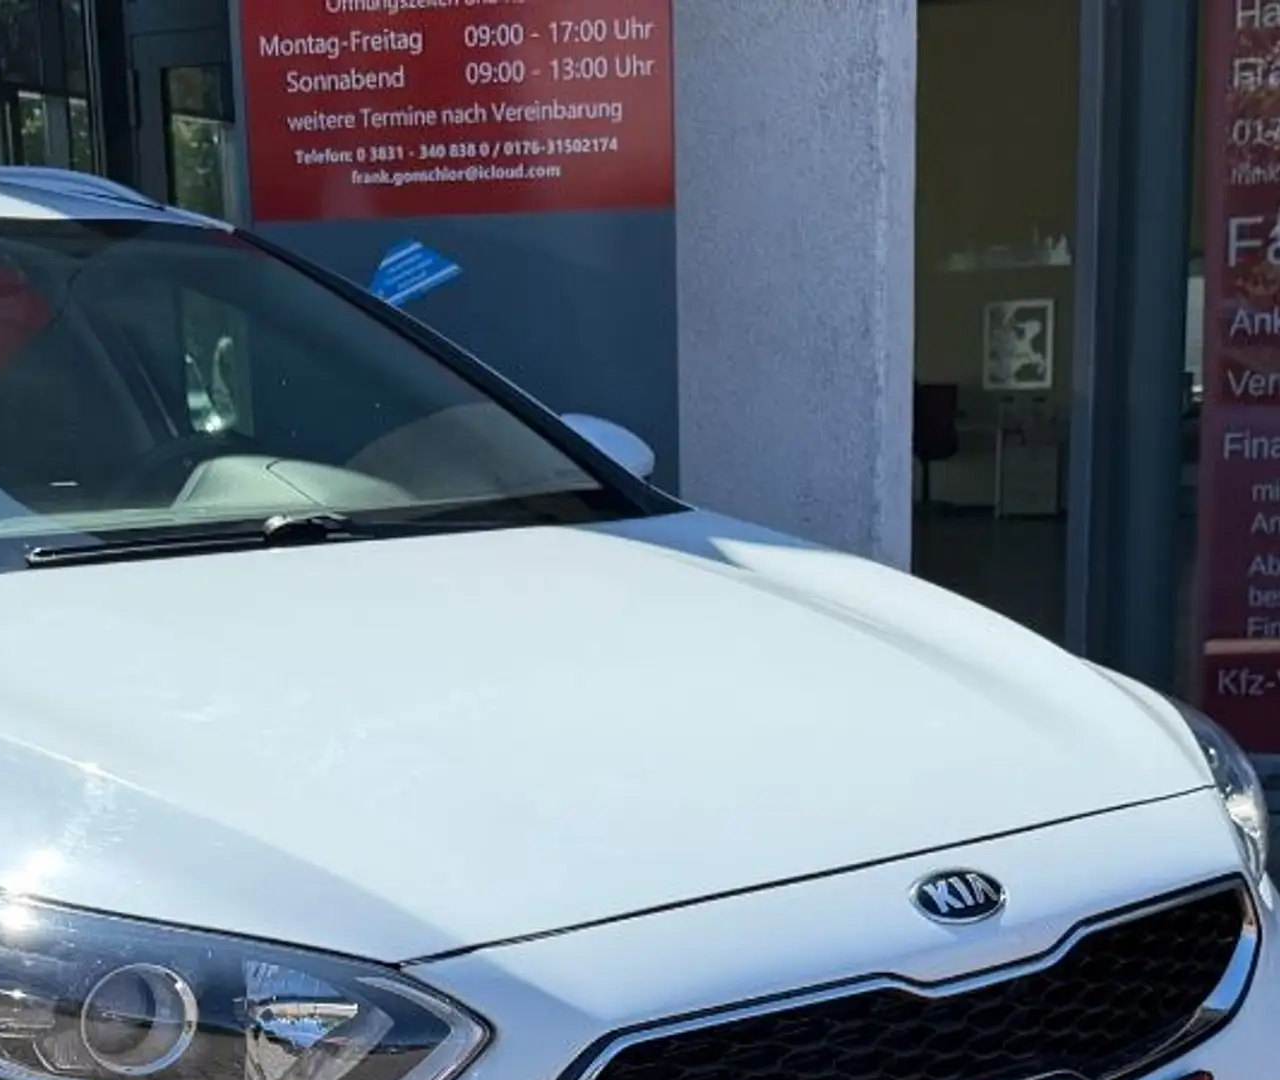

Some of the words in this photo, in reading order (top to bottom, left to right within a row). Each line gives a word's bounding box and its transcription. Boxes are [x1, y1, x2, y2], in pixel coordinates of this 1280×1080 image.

[259, 31, 423, 58] Montag-Freitag
[464, 25, 524, 48] 09:00
[549, 20, 607, 43] 17:00
[614, 17, 654, 40] Uhr
[286, 65, 405, 93] Sonnabend
[465, 61, 525, 85] 09:00
[550, 57, 609, 80] 13:00
[616, 54, 655, 78] Uhr
[287, 106, 356, 132] weitere
[360, 105, 436, 129] Termine
[442, 102, 486, 125] nach
[491, 99, 623, 126] Vereinbarung
[922, 872, 999, 914] KIA
